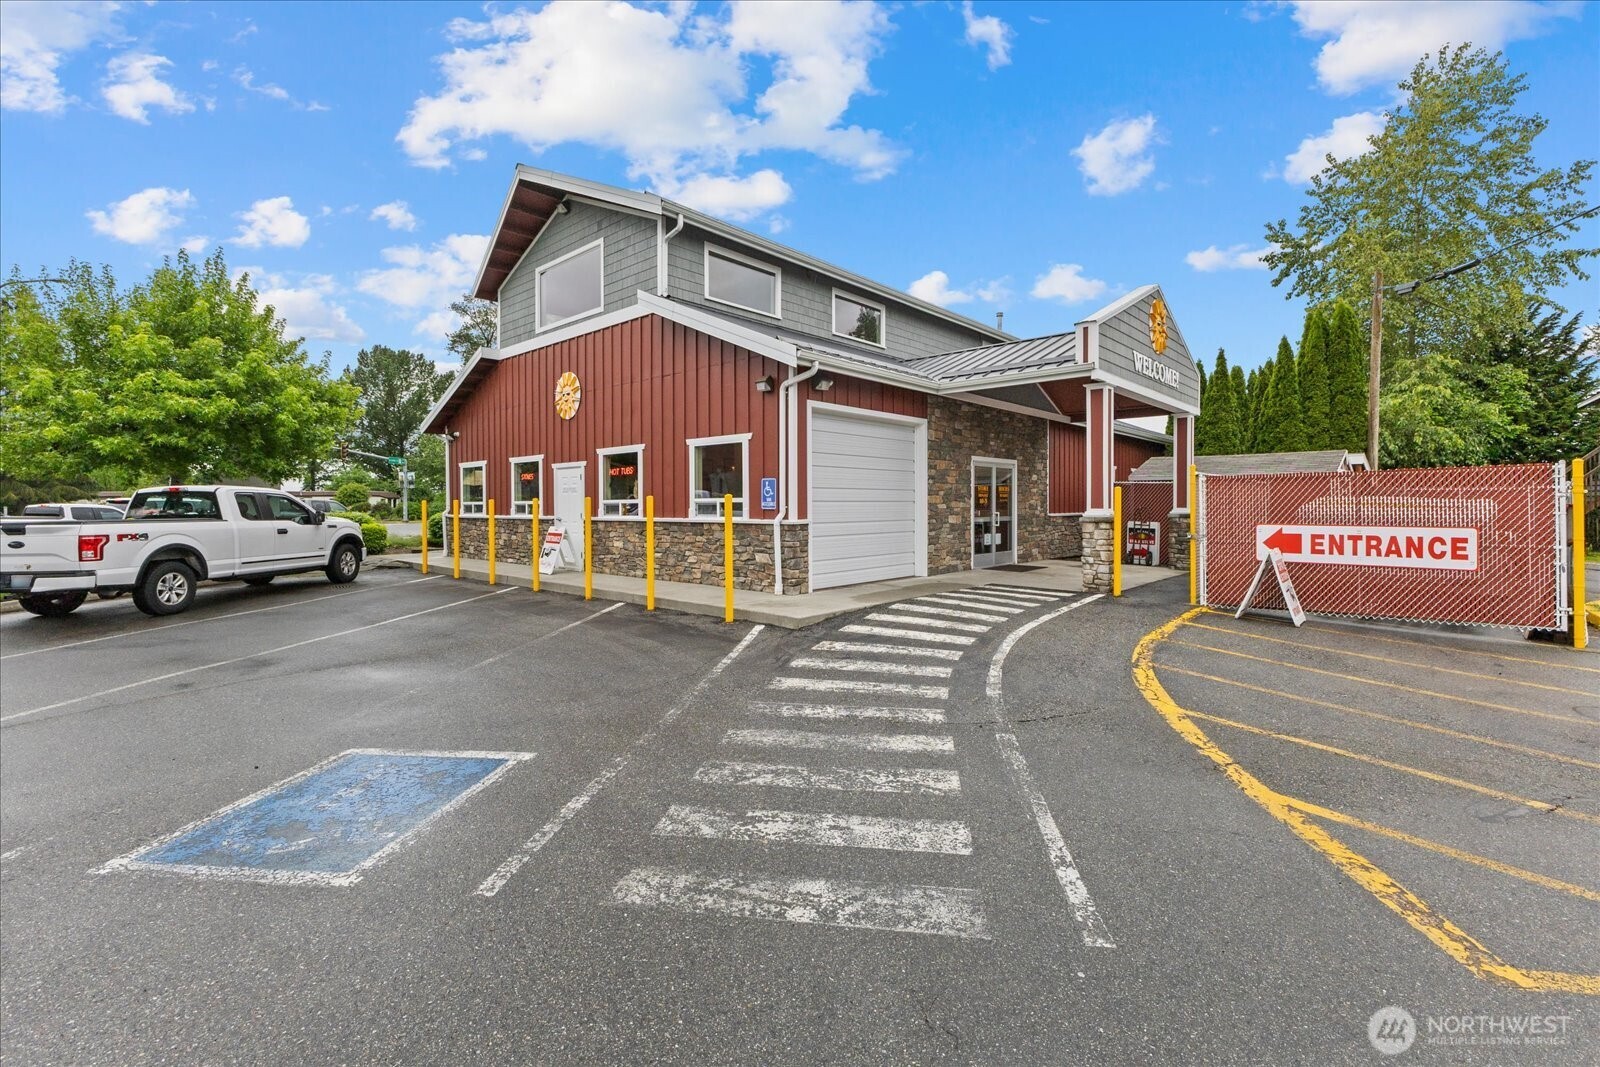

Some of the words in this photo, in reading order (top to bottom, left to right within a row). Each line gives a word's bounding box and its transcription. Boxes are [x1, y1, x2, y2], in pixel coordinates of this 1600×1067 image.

[1132, 350, 1179, 389] WELCOME!
[608, 468, 619, 476] HOT
[620, 466, 634, 475] TUBS
[117, 532, 149, 542] FX4
[1310, 533, 1469, 561] ENTRANCE
